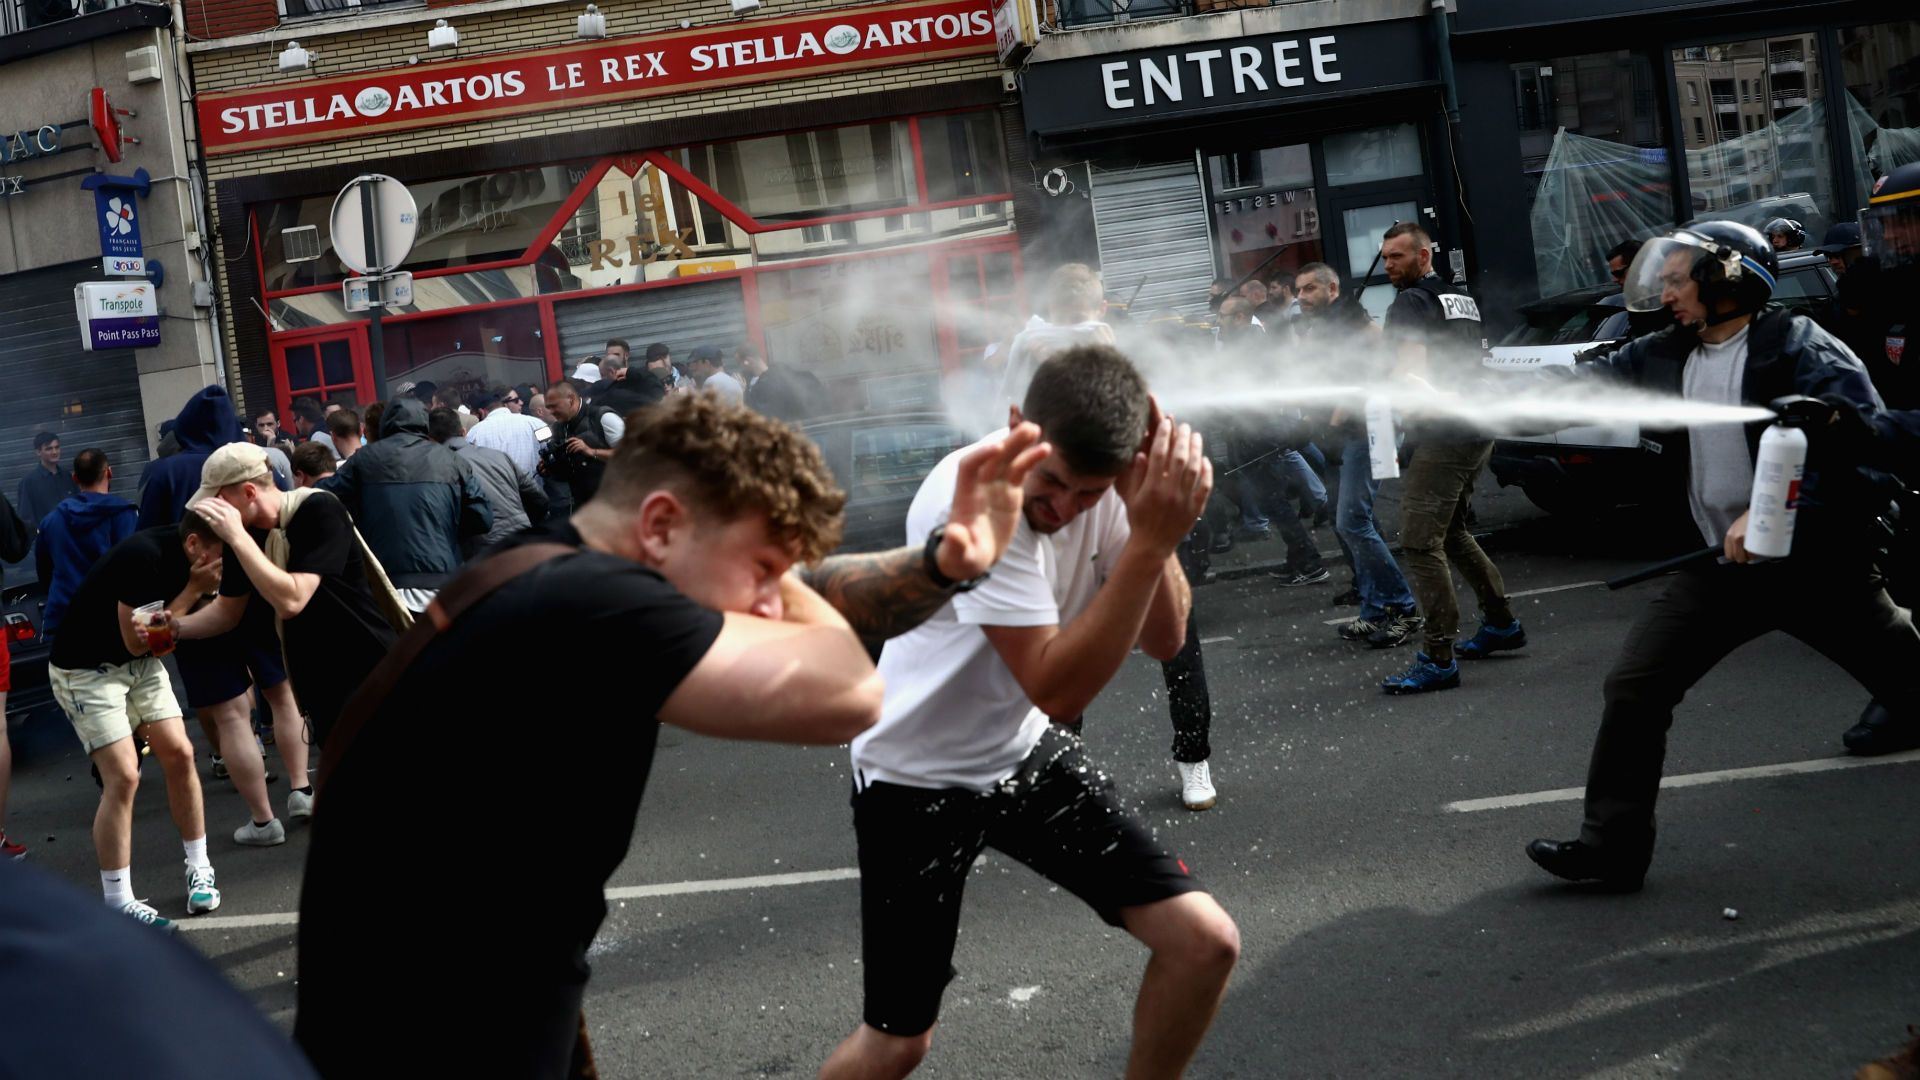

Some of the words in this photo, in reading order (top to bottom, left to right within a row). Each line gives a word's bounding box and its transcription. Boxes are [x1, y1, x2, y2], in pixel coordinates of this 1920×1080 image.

[691, 32, 823, 71] STELLA
[862, 10, 993, 50] ARTOIS
[546, 63, 585, 91] LE
[600, 52, 668, 84] REX
[1101, 35, 1342, 109] ENTREE
[221, 95, 357, 134] STELLA
[394, 71, 526, 112] ARTOIS
[0, 125, 58, 162] AC
[619, 191, 658, 216] le
[113, 260, 141, 272] LOTO
[587, 227, 697, 272] REX
[100, 298, 143, 313] Transpole
[1444, 297, 1479, 318] POLICE
[98, 330, 120, 341] Point
[121, 329, 140, 340] Pass
[141, 328, 159, 338] Pass
